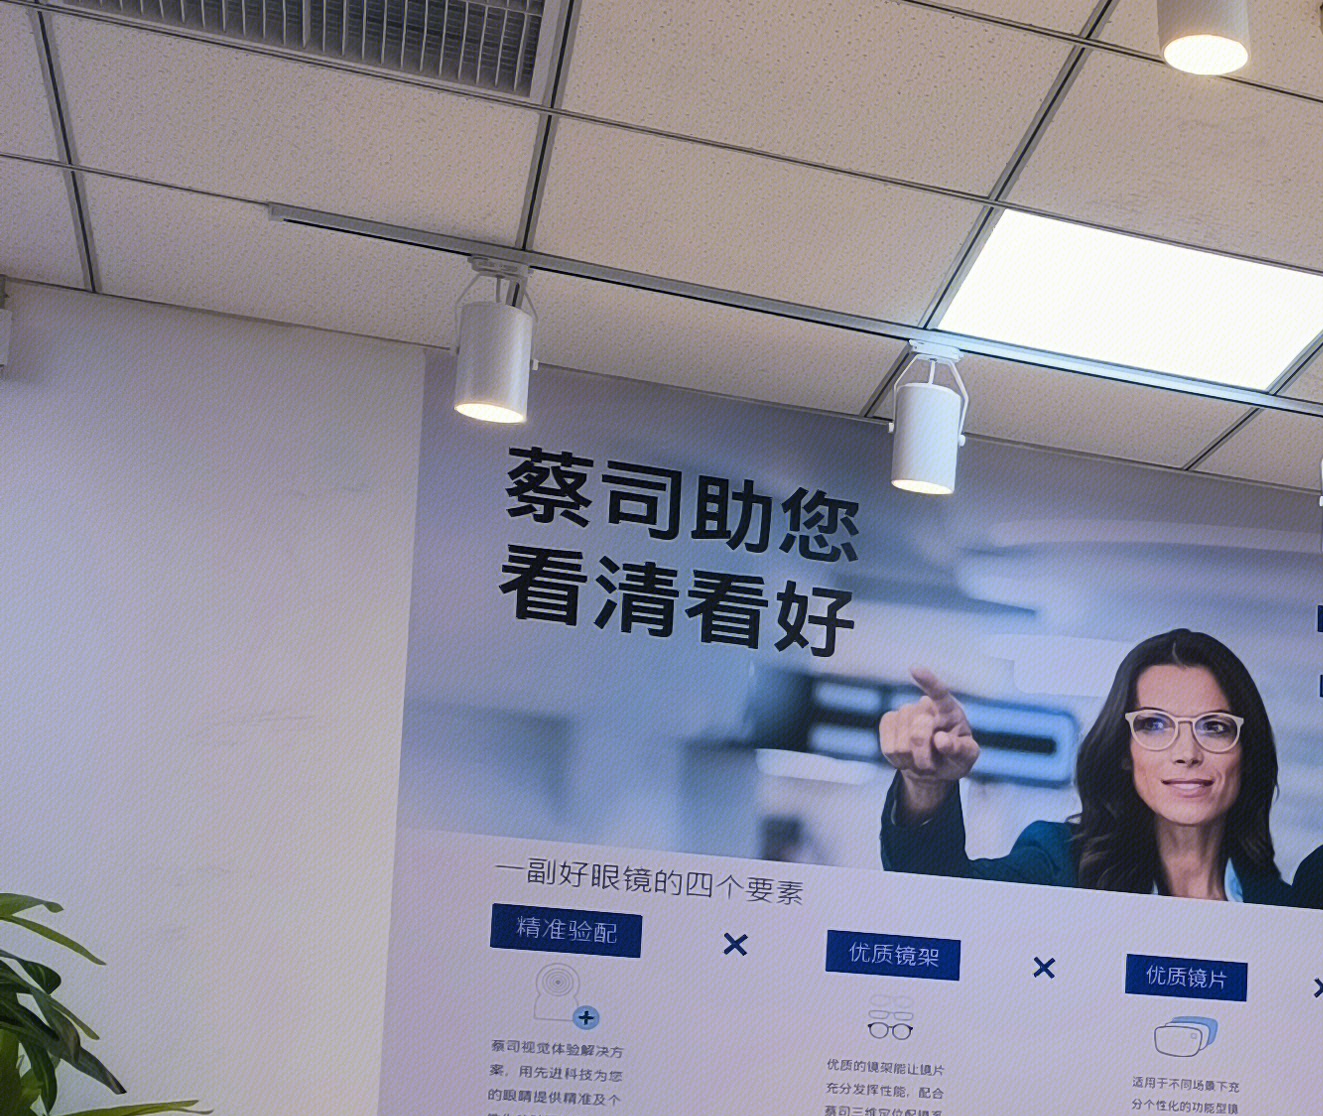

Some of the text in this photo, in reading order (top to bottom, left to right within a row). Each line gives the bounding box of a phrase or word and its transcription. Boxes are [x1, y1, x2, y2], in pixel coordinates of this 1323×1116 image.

[505, 446, 860, 564] 蔡司助您
[498, 543, 855, 658] 看清看好
[495, 857, 804, 906] 一副好眼镜的四个要素
[515, 915, 618, 945] 精准验配
[848, 940, 941, 969] 优质镜架
[1146, 964, 1228, 990] 优质镜片
[491, 1039, 624, 1059] 蔡司视觉体验解决方
[826, 1058, 945, 1077] 优质的镜架能让镜片
[487, 1088, 621, 1106] 的眼睛提供精准及个
[1132, 1075, 1240, 1093] 适用于不同场景下充
[1131, 1098, 1239, 1115] 分个性化的功能型镜
